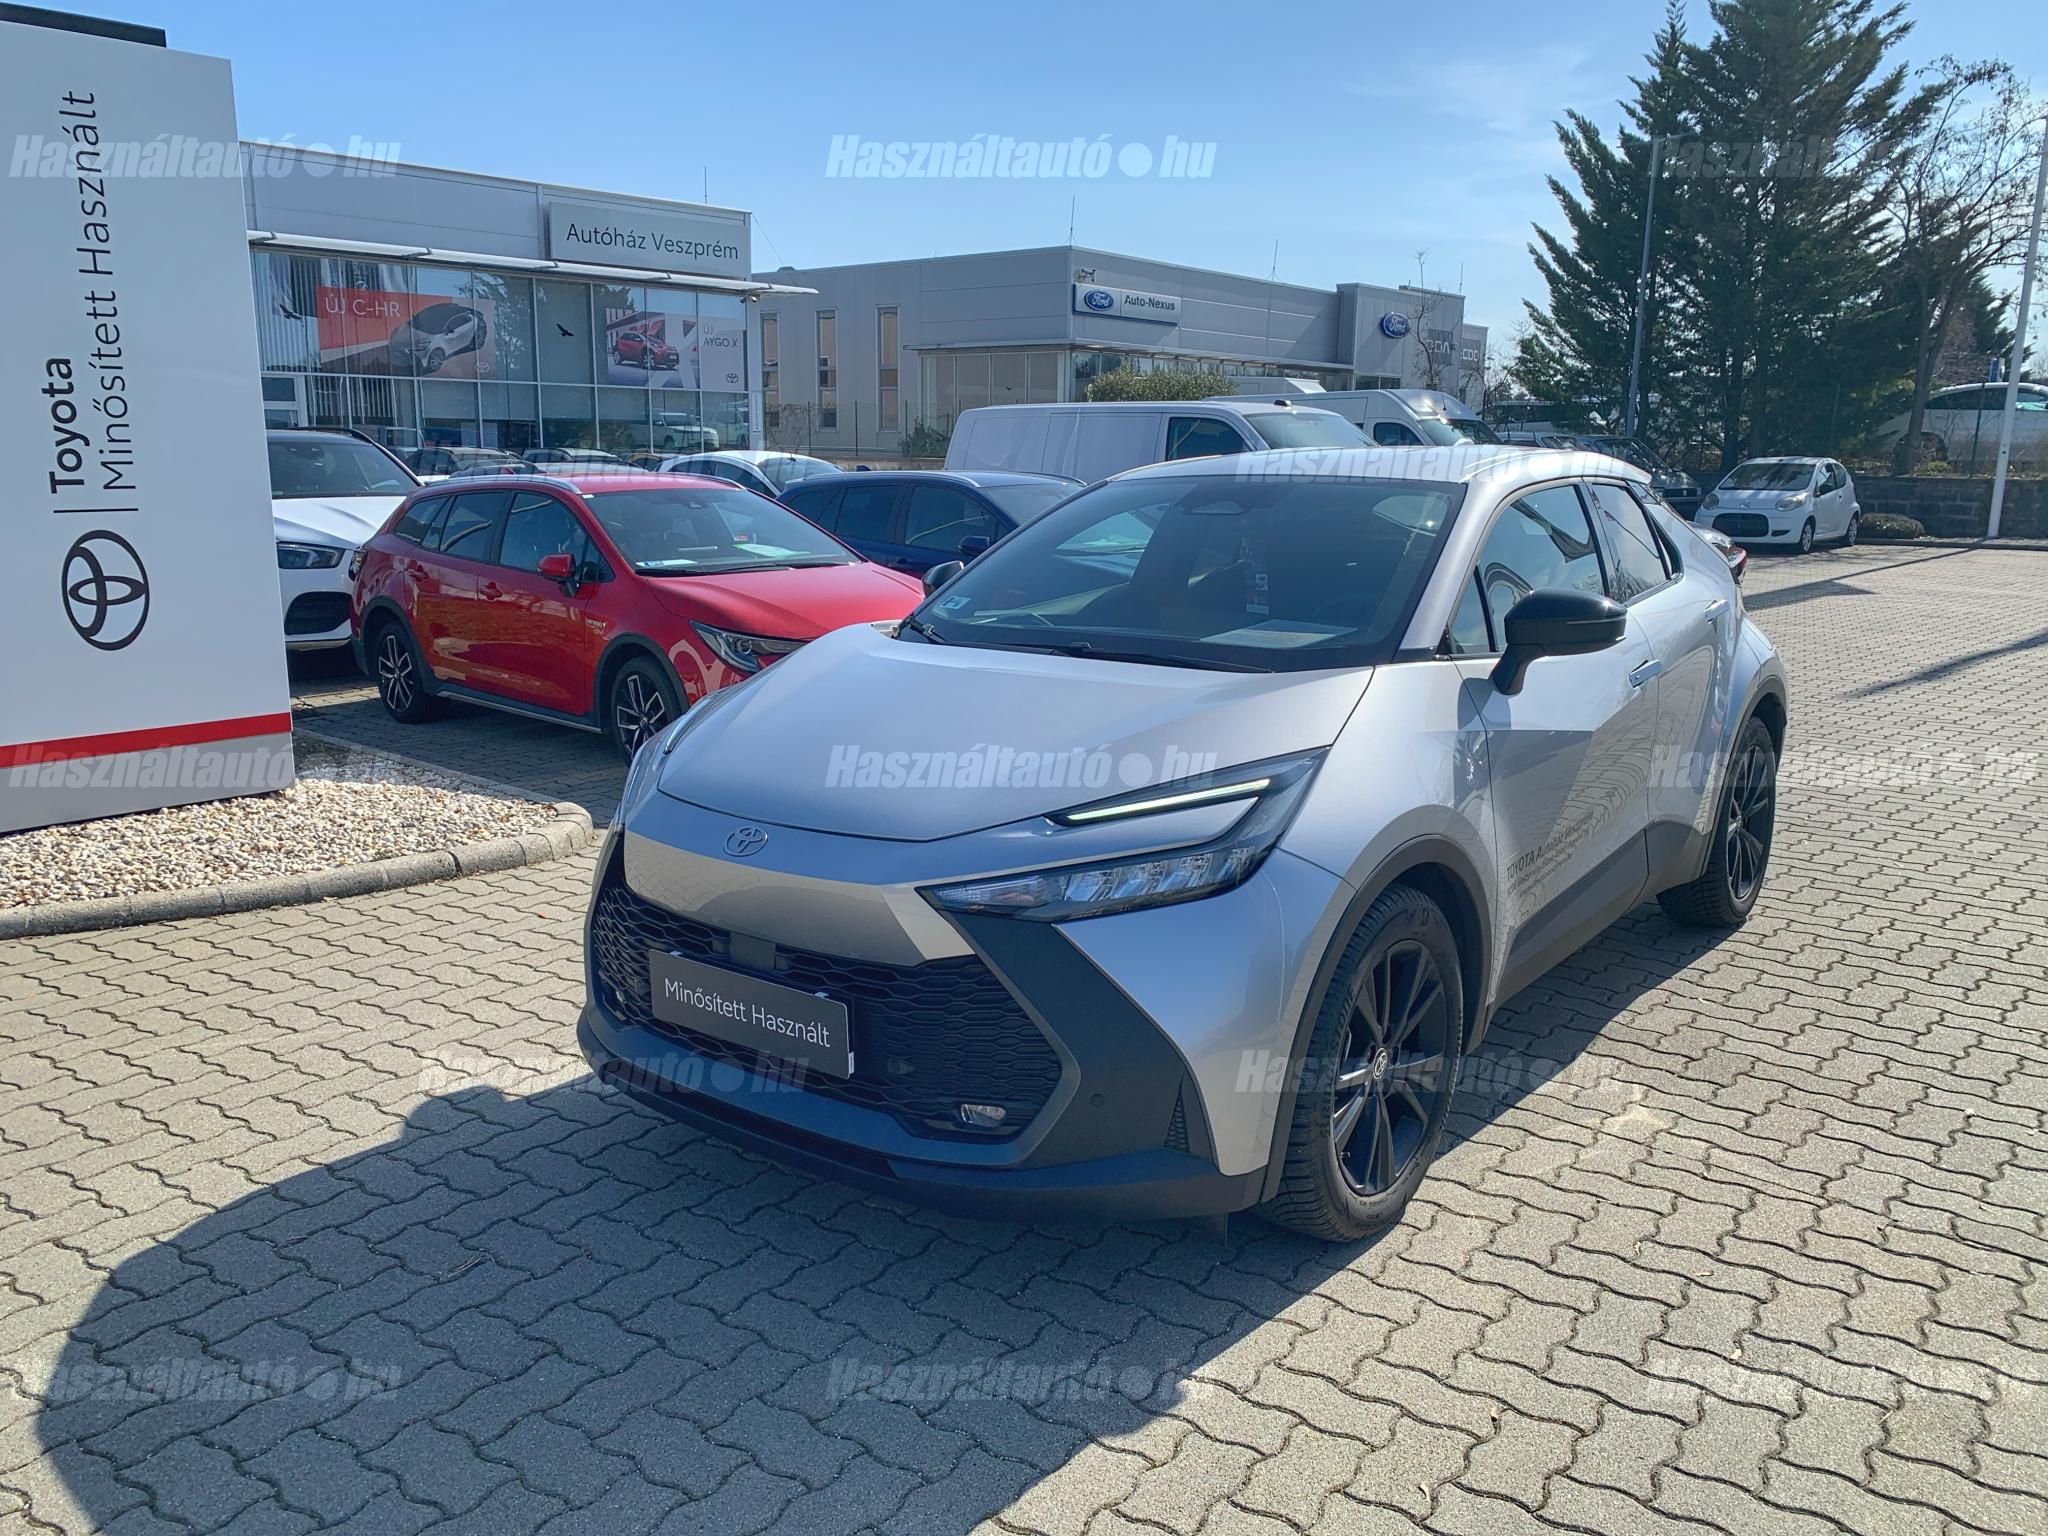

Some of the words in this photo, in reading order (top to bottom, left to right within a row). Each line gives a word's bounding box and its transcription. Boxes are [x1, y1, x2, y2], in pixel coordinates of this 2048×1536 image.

[59, 90, 114, 276] Használt
[566, 223, 647, 250] Autóház
[651, 232, 739, 260] Veszprém
[325, 292, 346, 314] ÚJ
[352, 298, 401, 318] C-HR
[1089, 291, 1112, 309] Ford
[1123, 294, 1176, 311] Auto-Nexus
[1387, 314, 1408, 334] Ford
[703, 336, 730, 348] AYGO
[731, 338, 738, 349] X
[85, 289, 137, 490] Minősített
[42, 357, 90, 494] Toyota
[1506, 850, 1535, 882] TOYOTA
[664, 977, 748, 1023] Minősített
[751, 1004, 831, 1048] Használt
